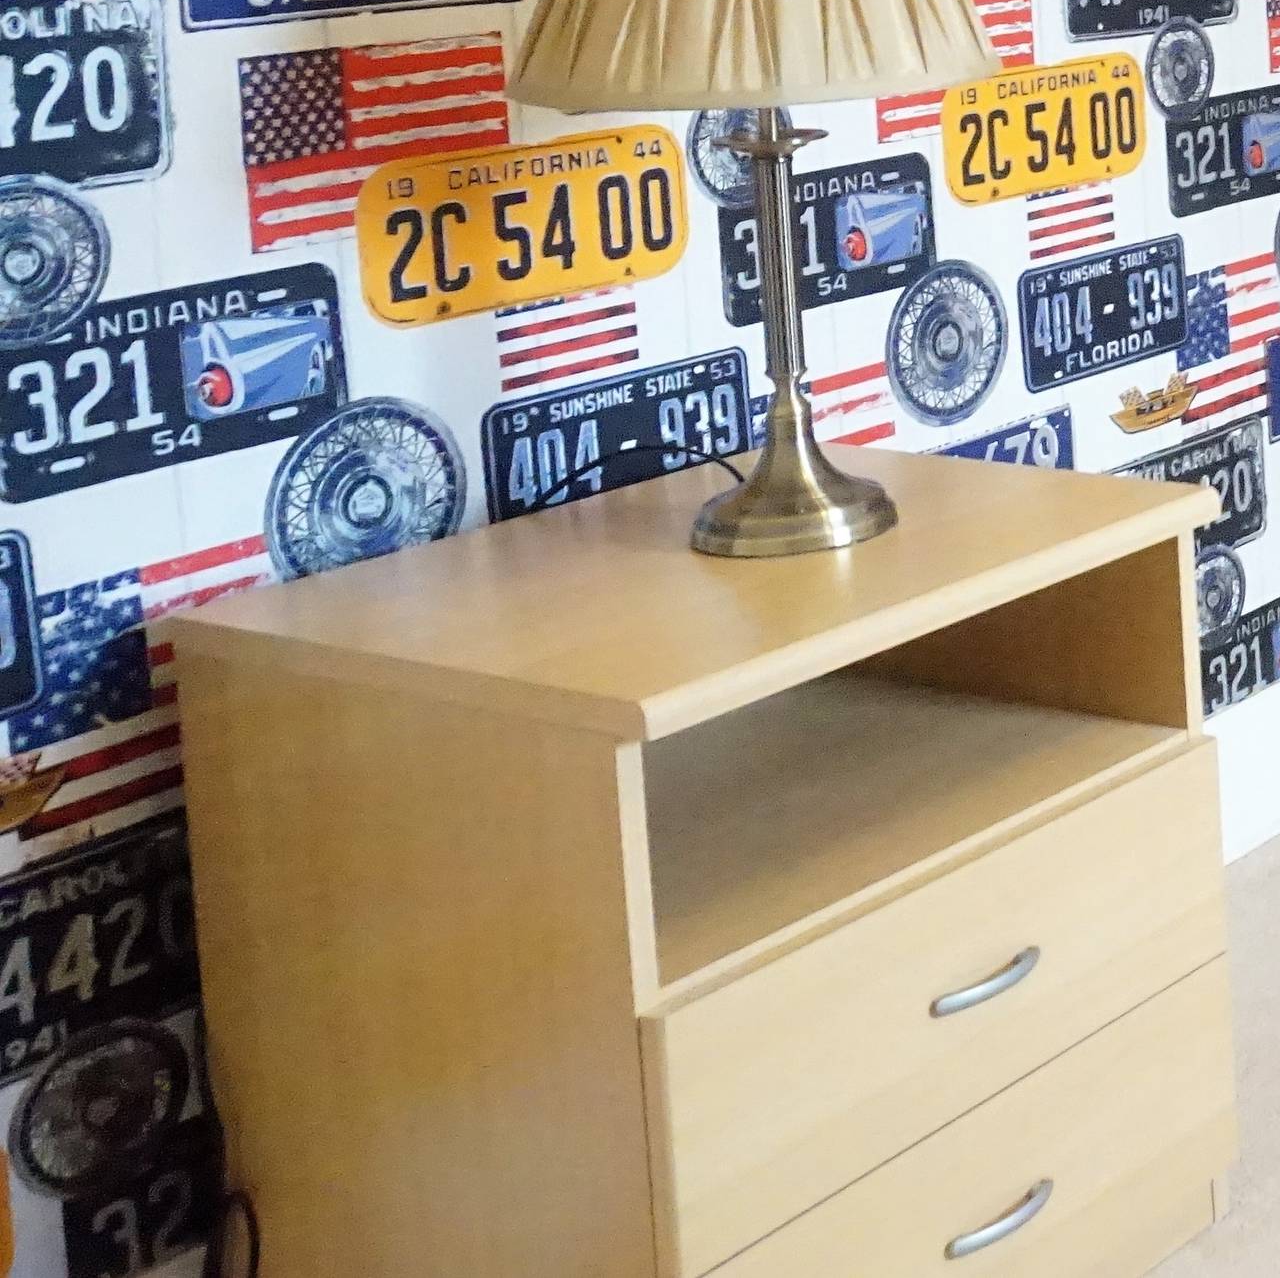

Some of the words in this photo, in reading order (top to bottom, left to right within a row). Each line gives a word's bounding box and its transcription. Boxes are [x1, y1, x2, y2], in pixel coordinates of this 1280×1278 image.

[959, 108, 1013, 188] 2C
[1026, 94, 1077, 177] 54
[1090, 87, 1139, 162] 00
[386, 201, 471, 304] 2C
[496, 182, 576, 283] 54
[598, 166, 675, 261] 00
[83, 288, 246, 346] INDIANA
[1034, 285, 1094, 359] 404
[1065, 331, 1156, 374] FLORIDA
[6, 336, 167, 458] 321
